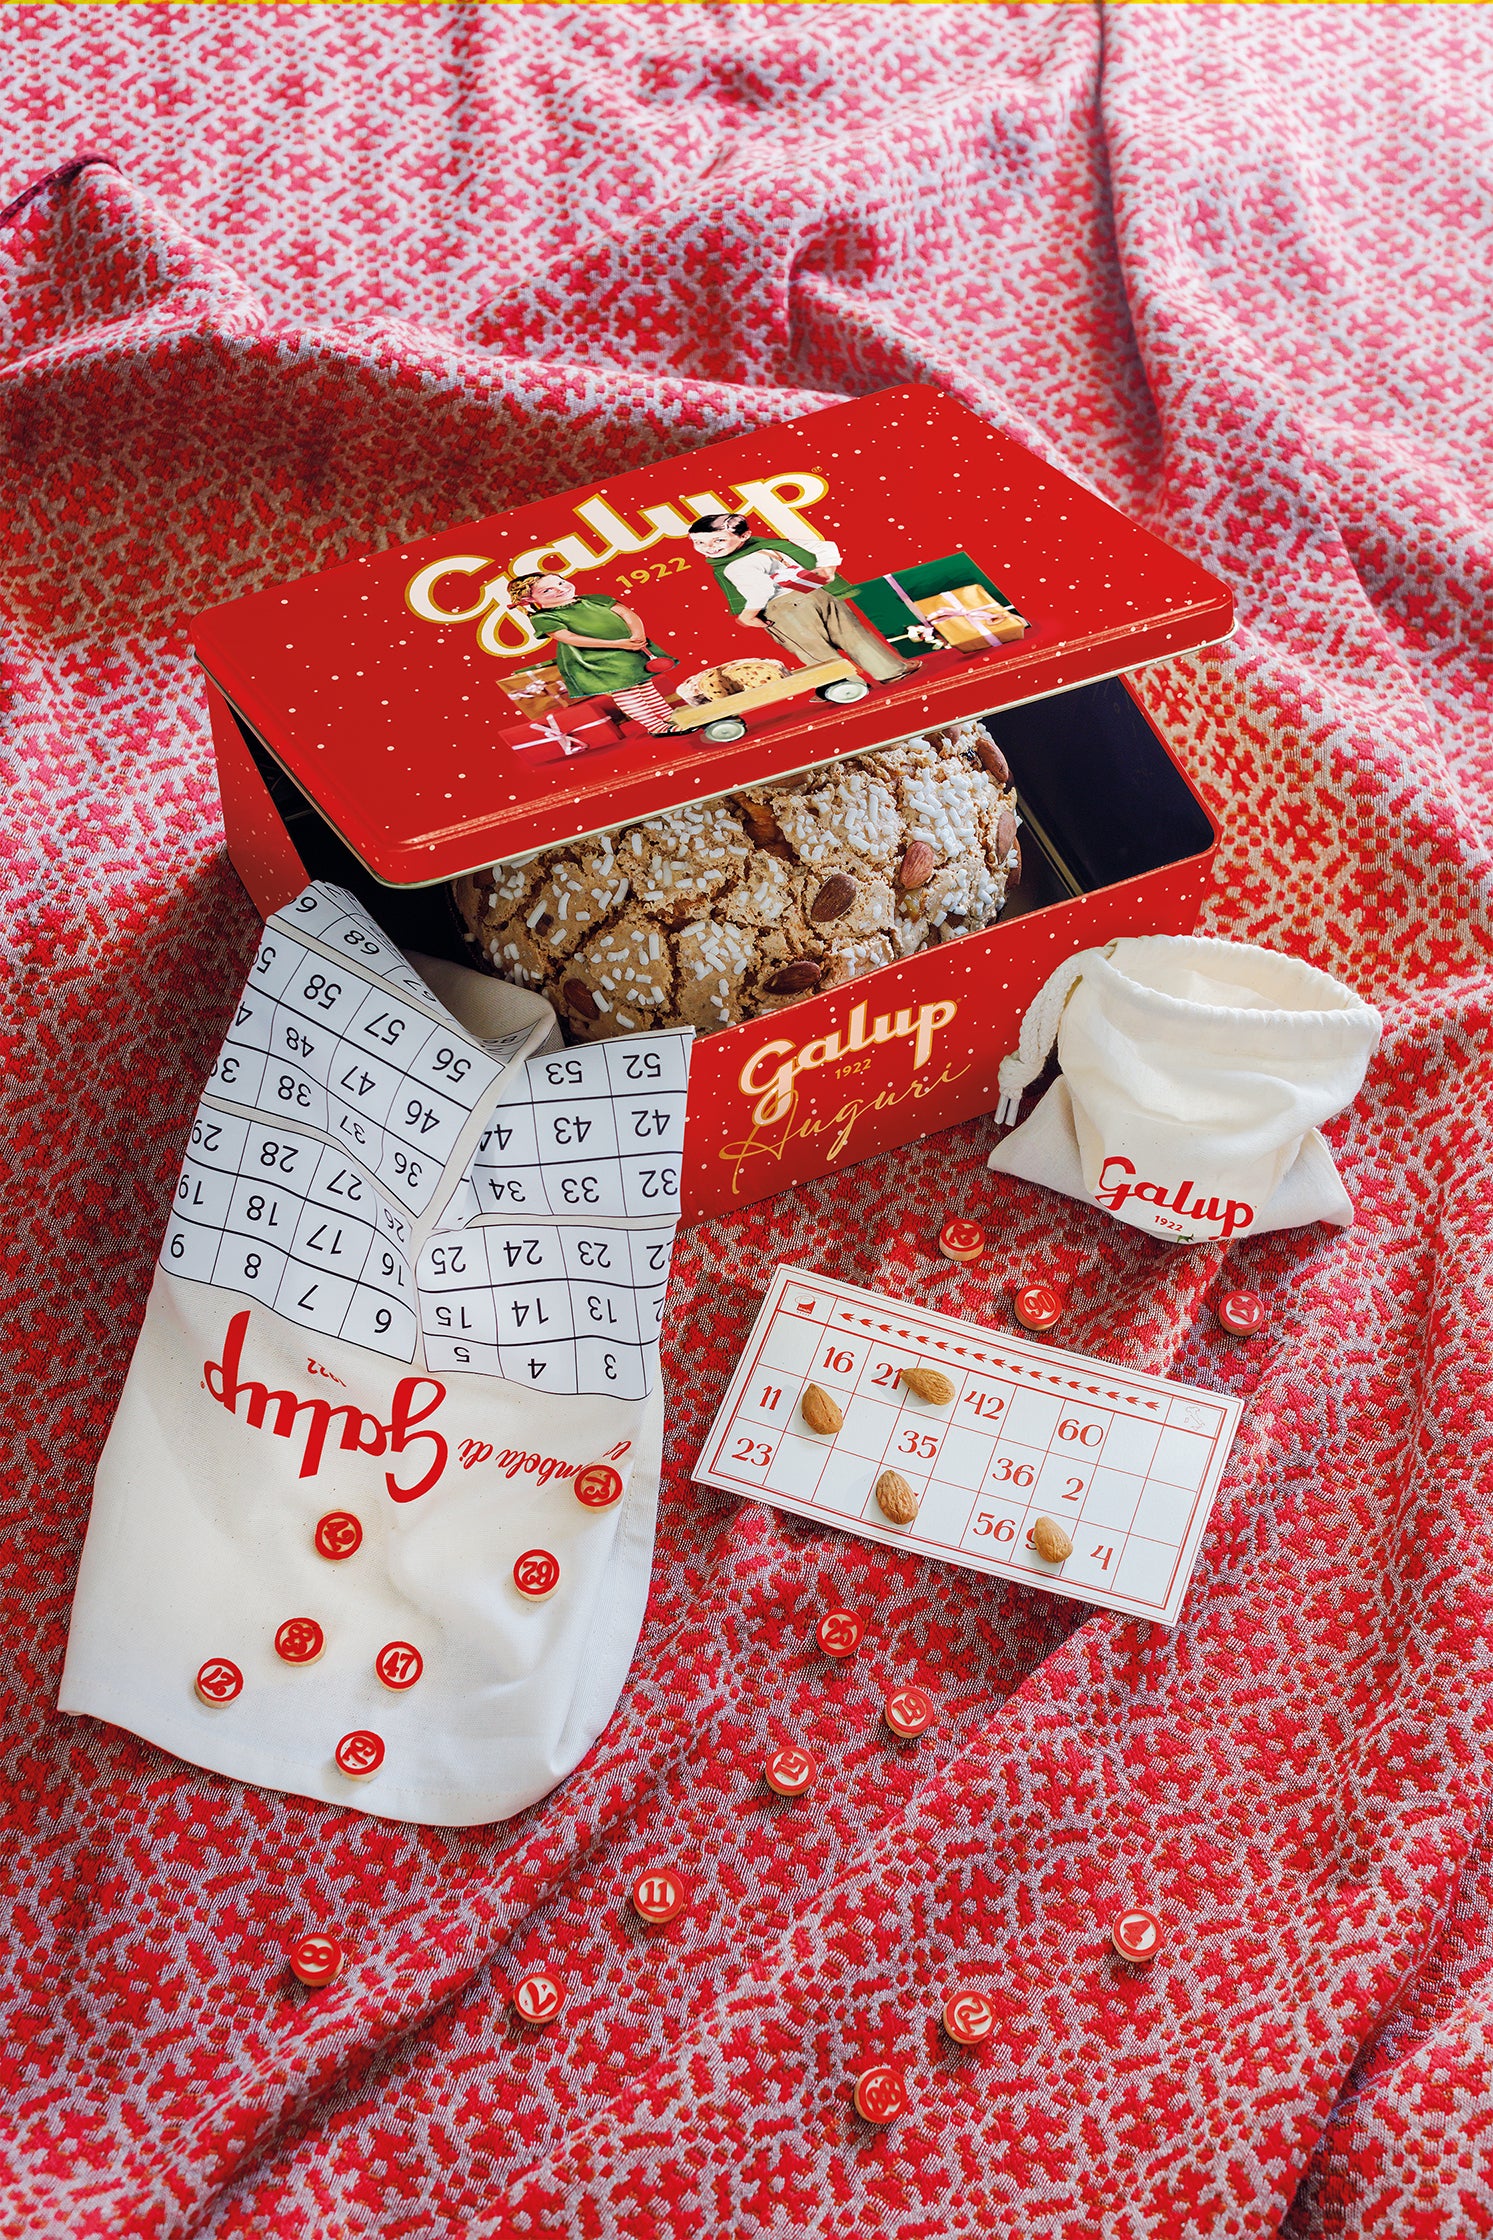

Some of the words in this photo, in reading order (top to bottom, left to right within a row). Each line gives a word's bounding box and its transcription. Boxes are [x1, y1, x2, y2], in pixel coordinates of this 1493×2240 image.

[405, 471, 830, 658] Galup
[615, 557, 692, 589] 1922
[288, 896, 318, 913] 6
[343, 930, 380, 956] 68
[253, 946, 277, 974] 5
[303, 974, 342, 1010] 58
[286, 1026, 315, 1058] 48
[364, 1012, 405, 1046] 57
[210, 1058, 240, 1083] 3
[432, 1048, 471, 1083] 56
[545, 1060, 583, 1085] 53
[622, 1052, 662, 1079] 52
[738, 999, 958, 1127] Galup
[835, 1058, 872, 1080] 1922
[278, 1075, 312, 1107] 38
[340, 1065, 376, 1096] 47
[339, 1115, 366, 1145] 37
[404, 1100, 440, 1134] 46
[553, 1116, 592, 1144] 43
[631, 1109, 671, 1137] 42
[718, 1062, 972, 1195] Auguri
[191, 1119, 223, 1152] 29
[260, 1141, 299, 1173] 28
[394, 1152, 423, 1188] 36
[178, 1174, 204, 1205] 19
[326, 1169, 363, 1201] 27
[488, 1178, 526, 1202] 34
[561, 1177, 600, 1204] 33
[639, 1168, 678, 1198] 32
[246, 1195, 278, 1226] 18
[1095, 1156, 1254, 1240] Galup
[384, 1208, 405, 1242] 26
[1153, 1214, 1183, 1232] 1922
[170, 1234, 185, 1258] 9
[306, 1224, 342, 1255] 17
[503, 1240, 543, 1268] 24
[244, 1253, 262, 1279] 8
[431, 1246, 466, 1275] 25
[577, 1241, 611, 1268] 23
[646, 1241, 673, 1270] 2
[382, 1252, 405, 1287] 16
[297, 1284, 319, 1311] 7
[587, 1295, 618, 1324] 13
[1024, 1290, 1056, 1318] 90
[1229, 1296, 1257, 1324] 37
[374, 1308, 392, 1333] 6
[435, 1306, 472, 1329] 15
[511, 1298, 549, 1327] 14
[453, 1346, 470, 1362] 5
[528, 1358, 547, 1379] 4
[604, 1353, 617, 1380] 3
[203, 1310, 448, 1503] Galup
[822, 1346, 855, 1373] 16
[871, 1363, 903, 1390] 21
[963, 1391, 1005, 1420] 42
[1057, 1419, 1104, 1447] 60
[459, 1437, 494, 1471] di
[759, 1385, 782, 1411] 11
[898, 1430, 939, 1459] 35
[992, 1458, 1035, 1487] 36
[1061, 1477, 1084, 1501] 2
[582, 1474, 612, 1501] 73
[731, 1437, 773, 1467] 23
[972, 1512, 1016, 1542] 56
[1090, 1545, 1114, 1570] 4
[322, 1519, 351, 1552] 42
[520, 1559, 553, 1585] 62
[823, 1617, 856, 1645] 25
[383, 1652, 415, 1680] 47
[201, 1667, 236, 1698] 27
[774, 1752, 804, 1782] 51
[644, 1879, 671, 1910] 11
[1124, 1919, 1150, 1947] 4
[298, 1944, 333, 1967] 8
[526, 1981, 557, 2014] 7
